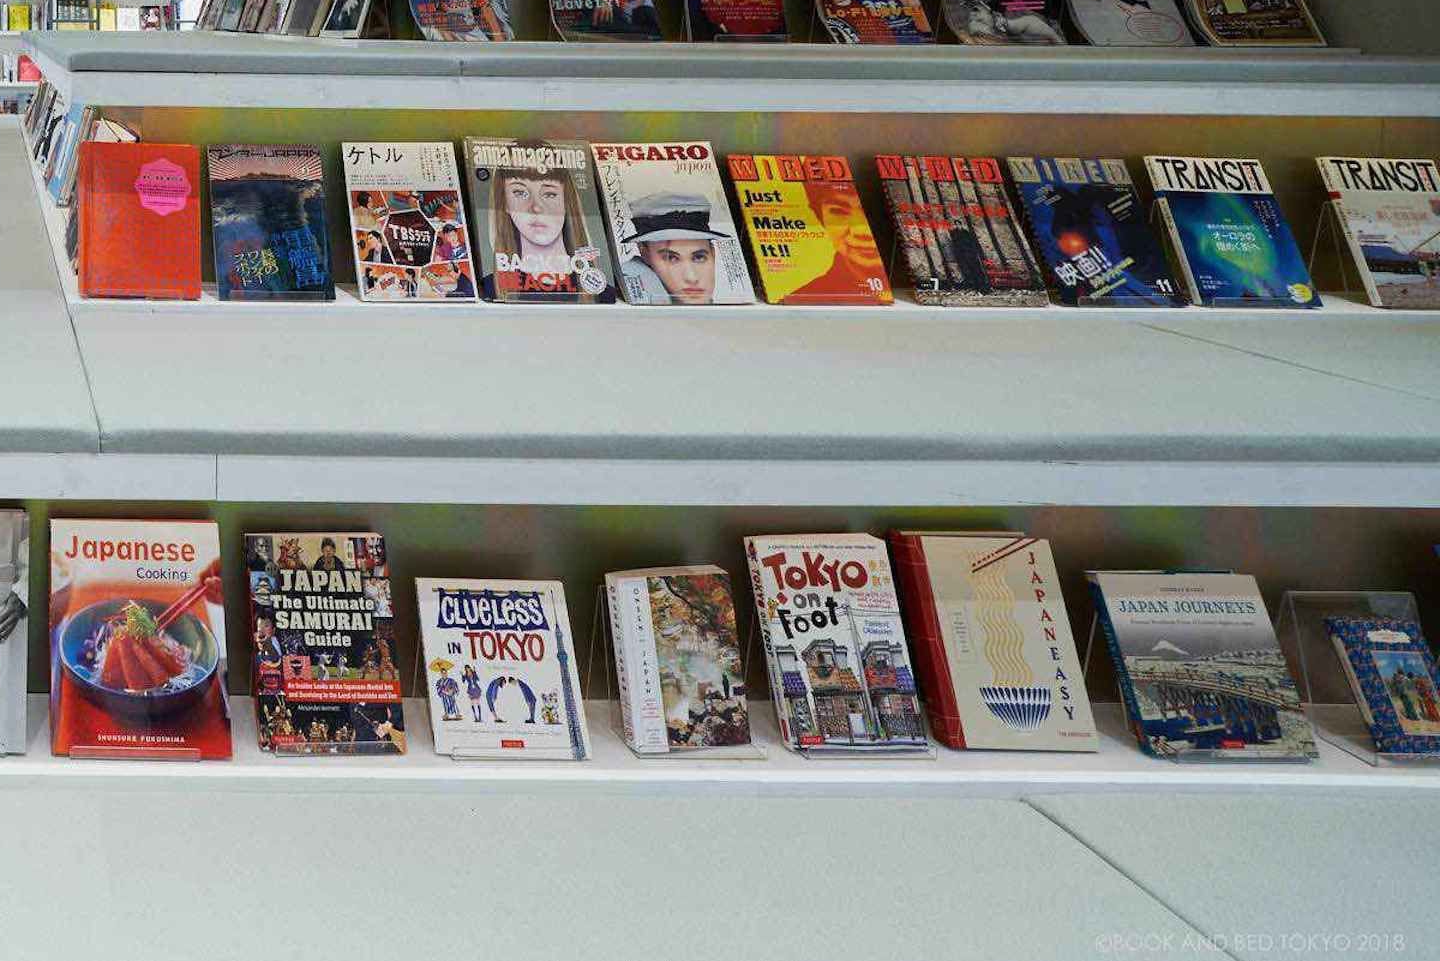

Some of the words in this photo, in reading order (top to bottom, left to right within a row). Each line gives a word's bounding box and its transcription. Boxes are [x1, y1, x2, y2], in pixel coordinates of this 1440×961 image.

[348, 146, 403, 165] ケトル
[595, 145, 709, 161] FIGARO
[728, 155, 851, 181] WIRED
[876, 156, 1004, 184] WIRED
[1155, 158, 1265, 192] TRANSIT
[1330, 159, 1438, 192] TRANSIT
[753, 216, 806, 230] Make
[65, 535, 196, 562] Japanese
[136, 567, 188, 582] Cooking
[280, 569, 363, 593] JAPAN
[271, 595, 302, 609] The
[306, 596, 375, 611] Ultimate
[1119, 600, 1169, 613] JAPAN
[1173, 600, 1257, 614] JOURNEYS
[275, 612, 373, 631] SAMURAI
[777, 596, 839, 639] Foot
[304, 632, 352, 648] Guide
[447, 642, 462, 655] IN
[463, 631, 546, 662] TOKYO
[1027, 551, 1075, 721] JAPANEASY
